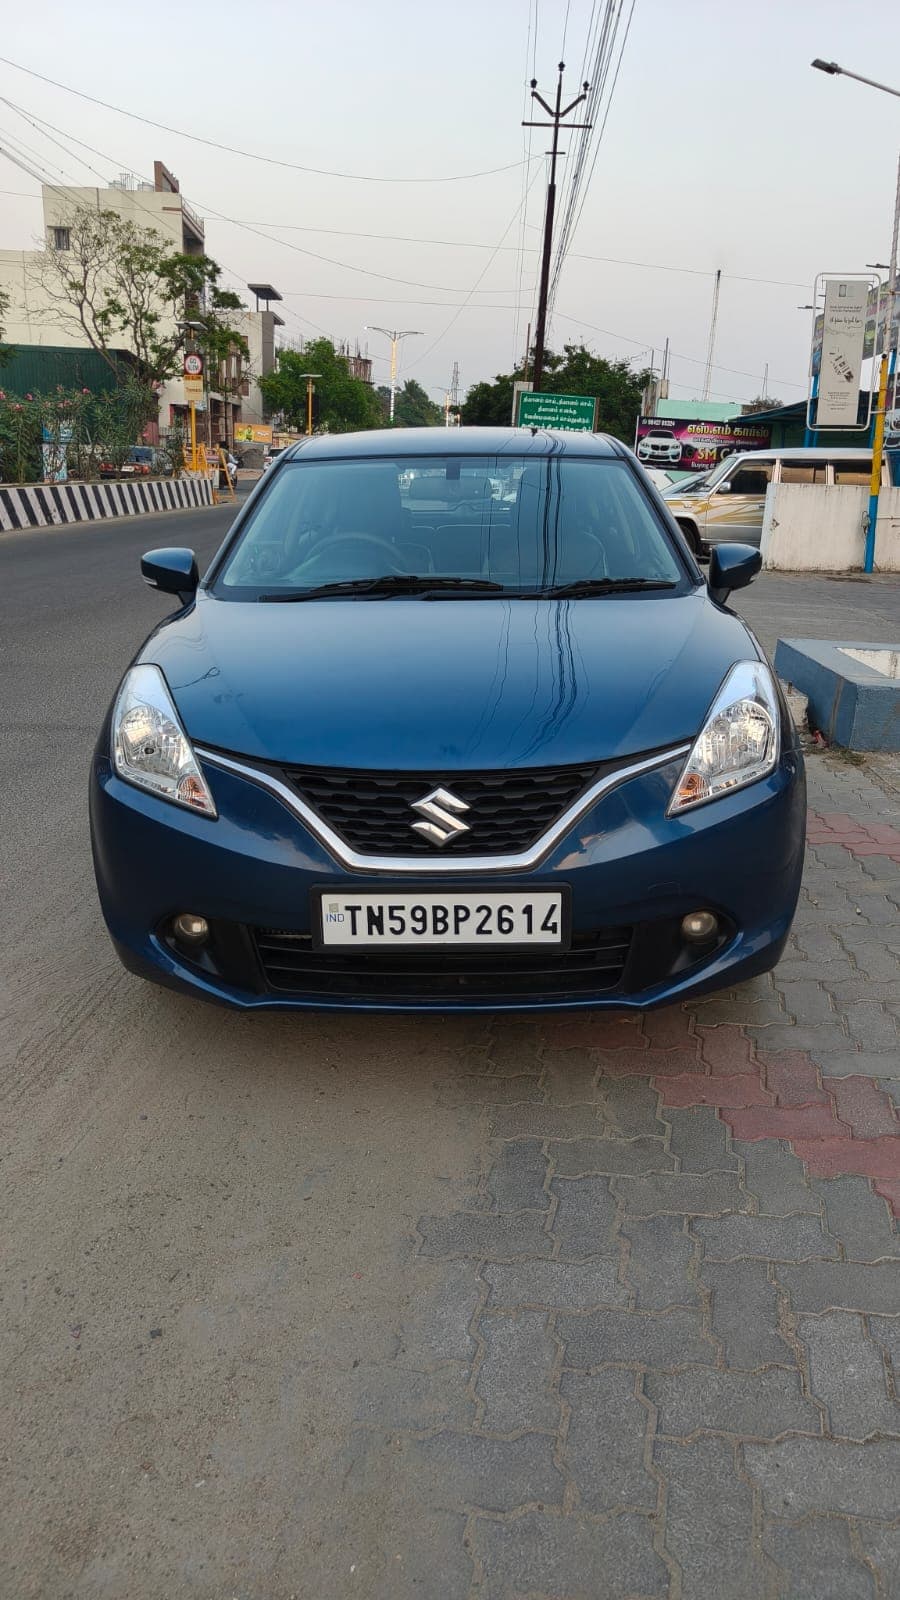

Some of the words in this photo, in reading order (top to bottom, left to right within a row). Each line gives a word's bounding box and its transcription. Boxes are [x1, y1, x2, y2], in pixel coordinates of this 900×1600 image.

[687, 422, 731, 436] எஸ்.எம்
[698, 448, 717, 459] SM
[326, 913, 345, 923] IND
[345, 903, 558, 936] TN59BP2614
